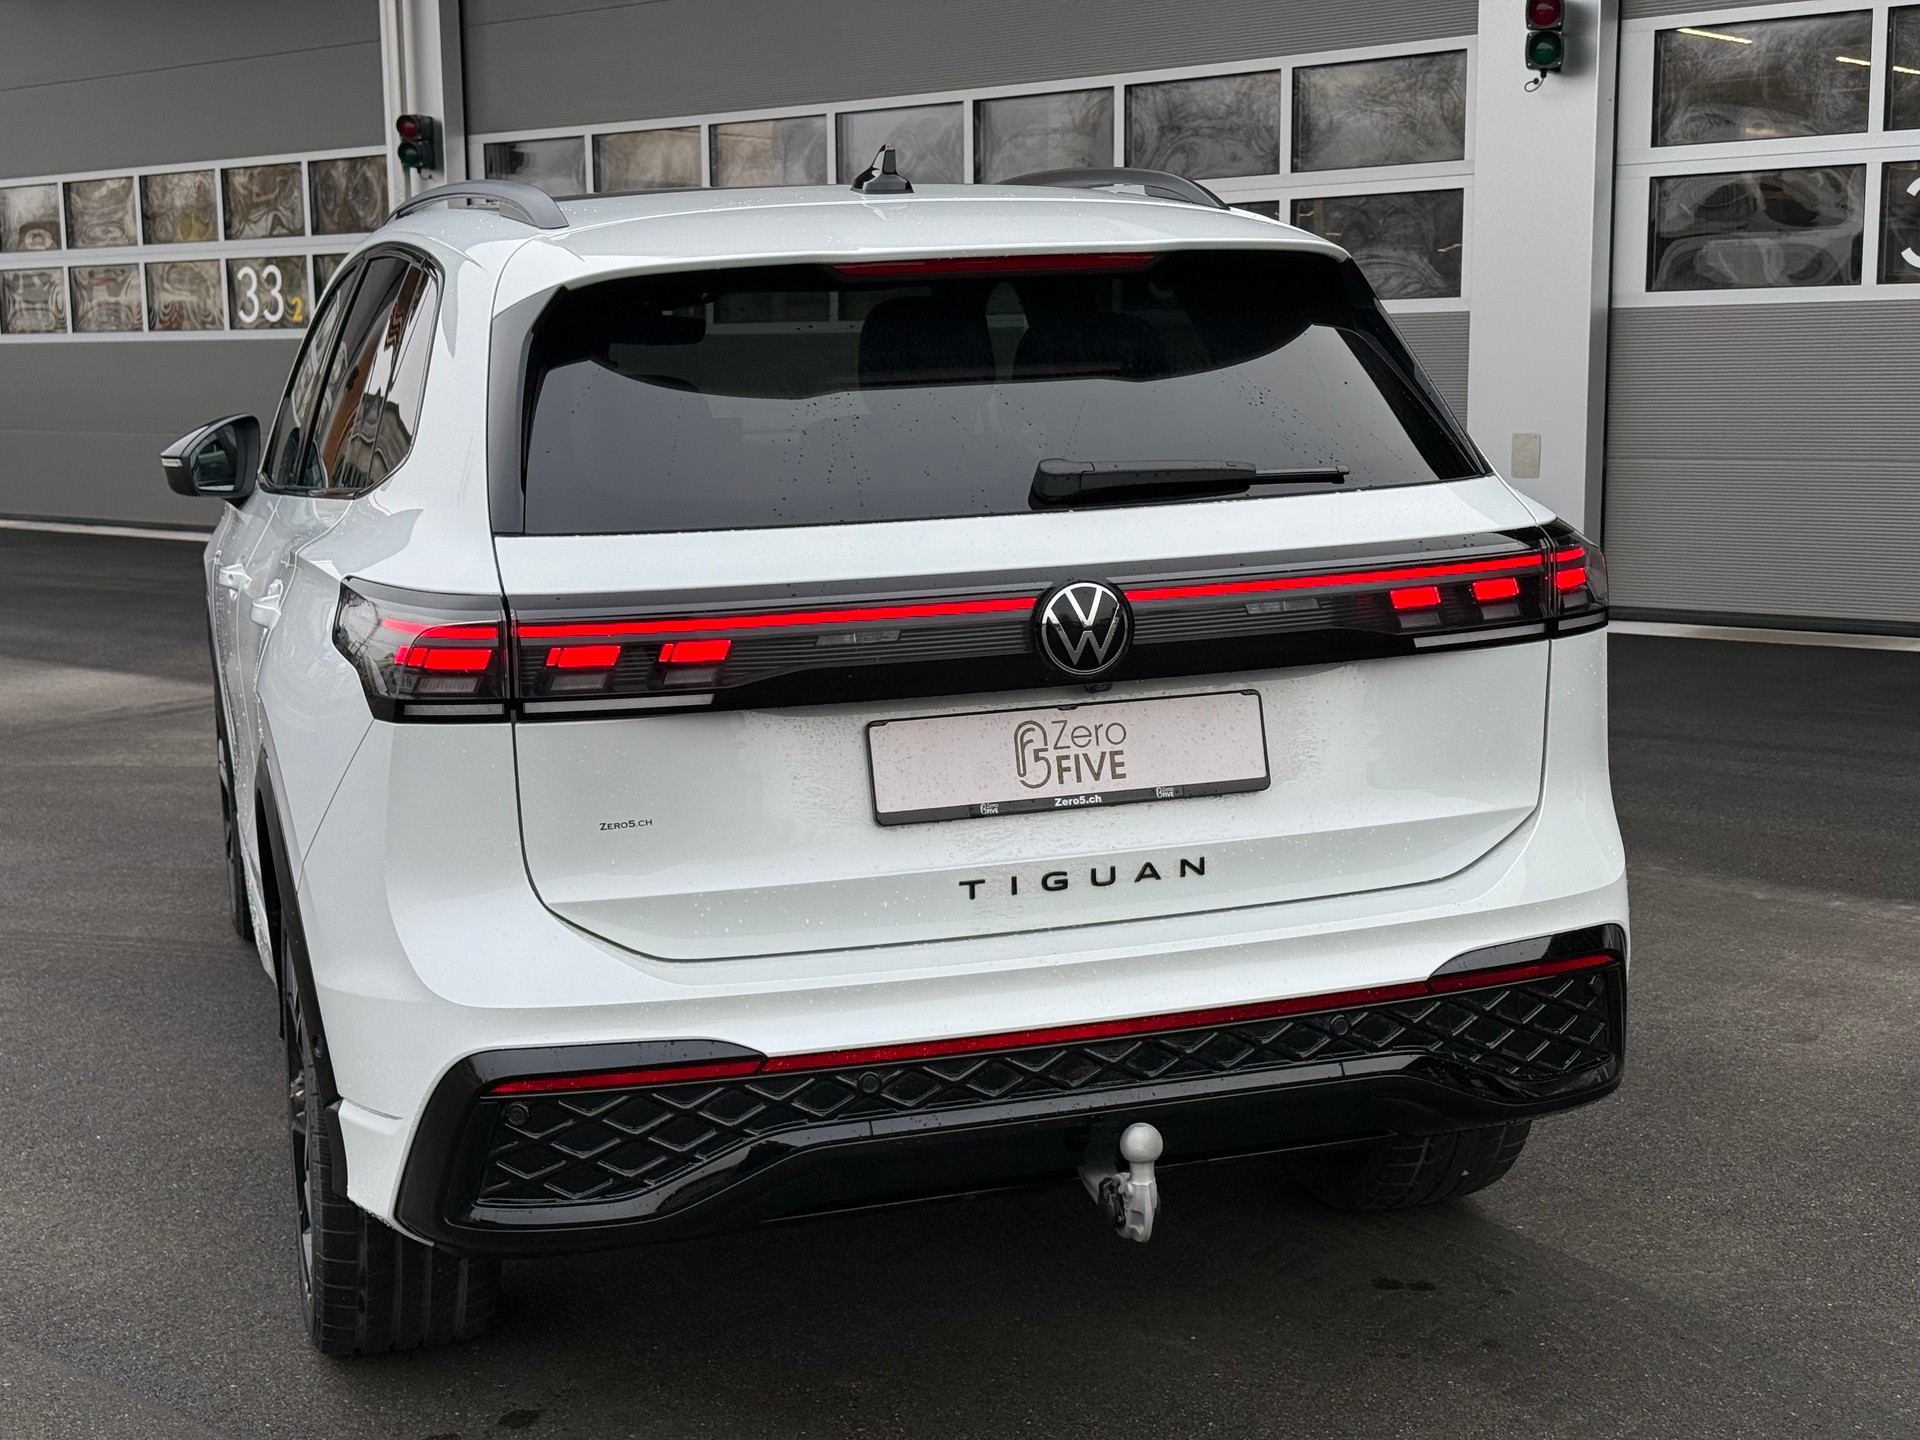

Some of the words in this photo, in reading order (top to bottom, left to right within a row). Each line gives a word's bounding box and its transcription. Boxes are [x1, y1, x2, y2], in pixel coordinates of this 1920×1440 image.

[237, 264, 284, 323] 33
[291, 296, 304, 322] 2
[1051, 719, 1127, 750] Zero
[1055, 750, 1127, 785] FIVE
[1054, 794, 1102, 807] Zero5.ch
[959, 856, 1205, 900] TIGUAN
